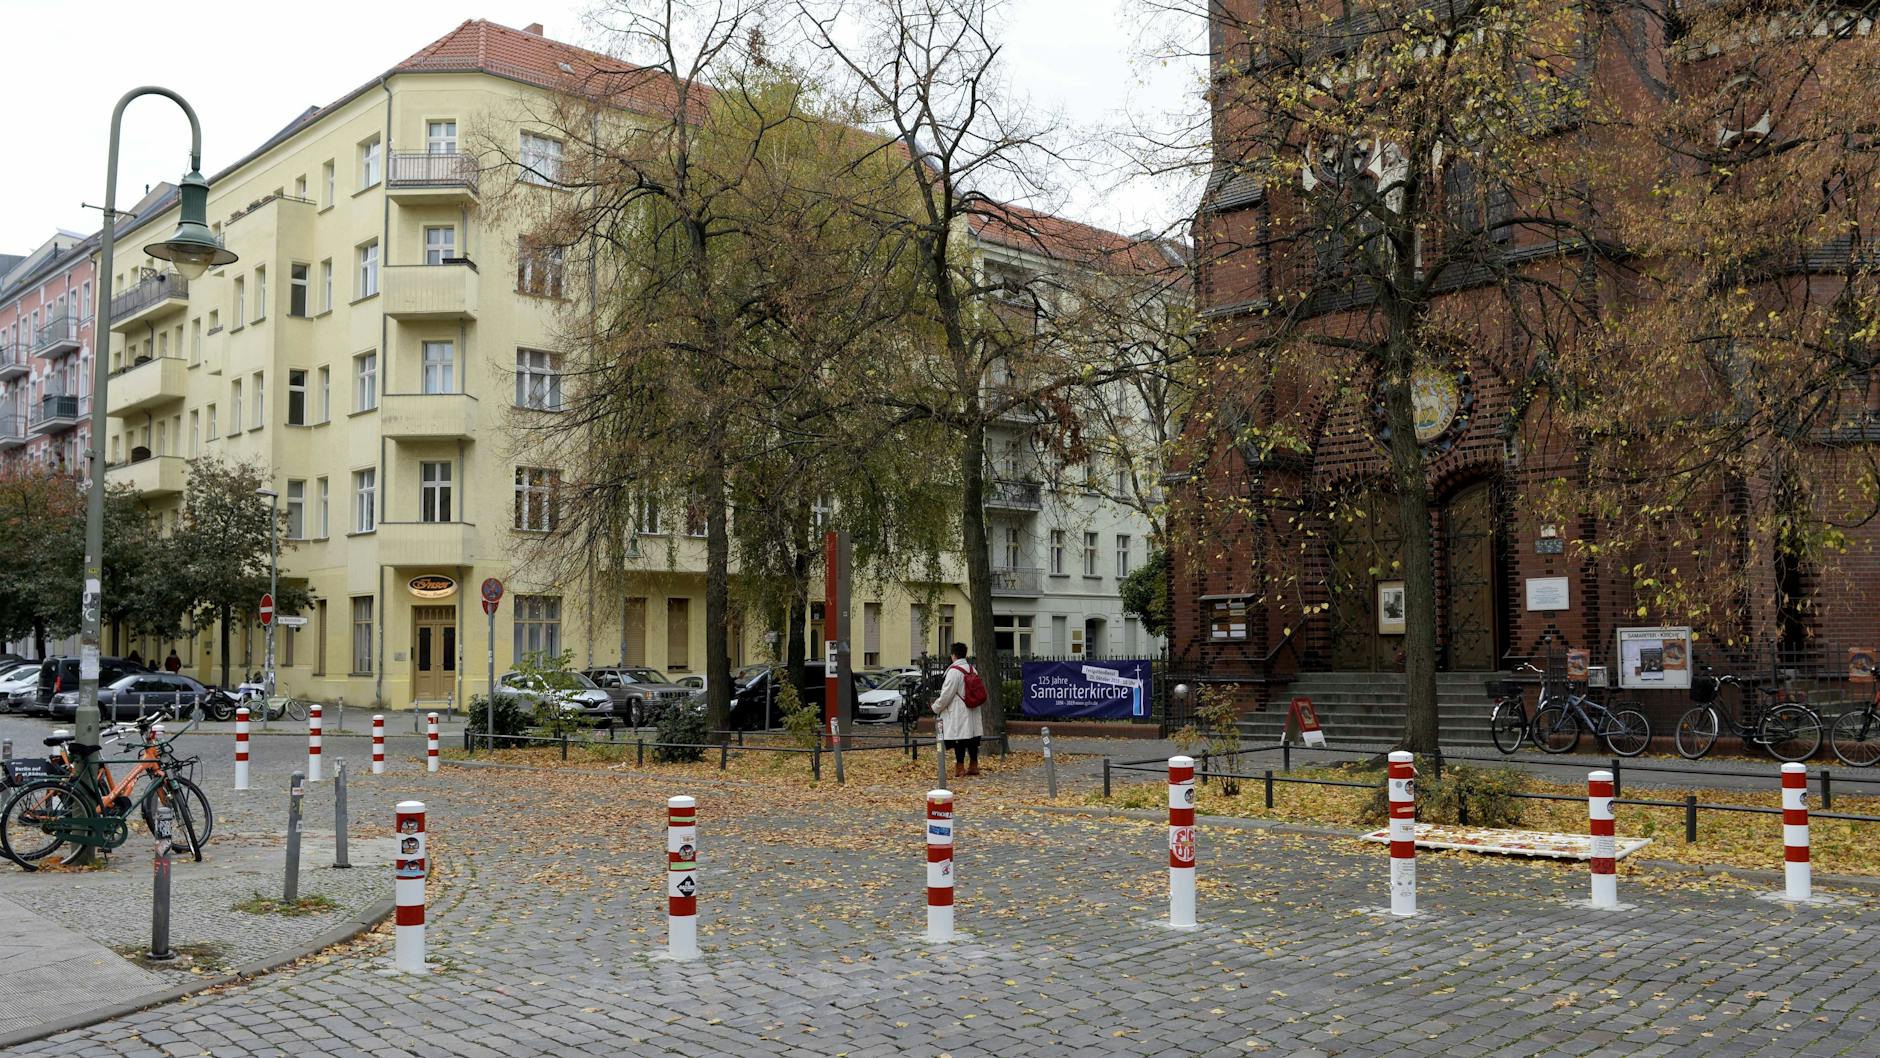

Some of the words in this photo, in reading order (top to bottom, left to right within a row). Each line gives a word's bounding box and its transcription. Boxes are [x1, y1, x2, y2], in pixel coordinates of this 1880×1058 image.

[1038, 676, 1050, 685] 125
[1051, 676, 1069, 686] Jahre
[1030, 682, 1129, 699] Samariterkirche
